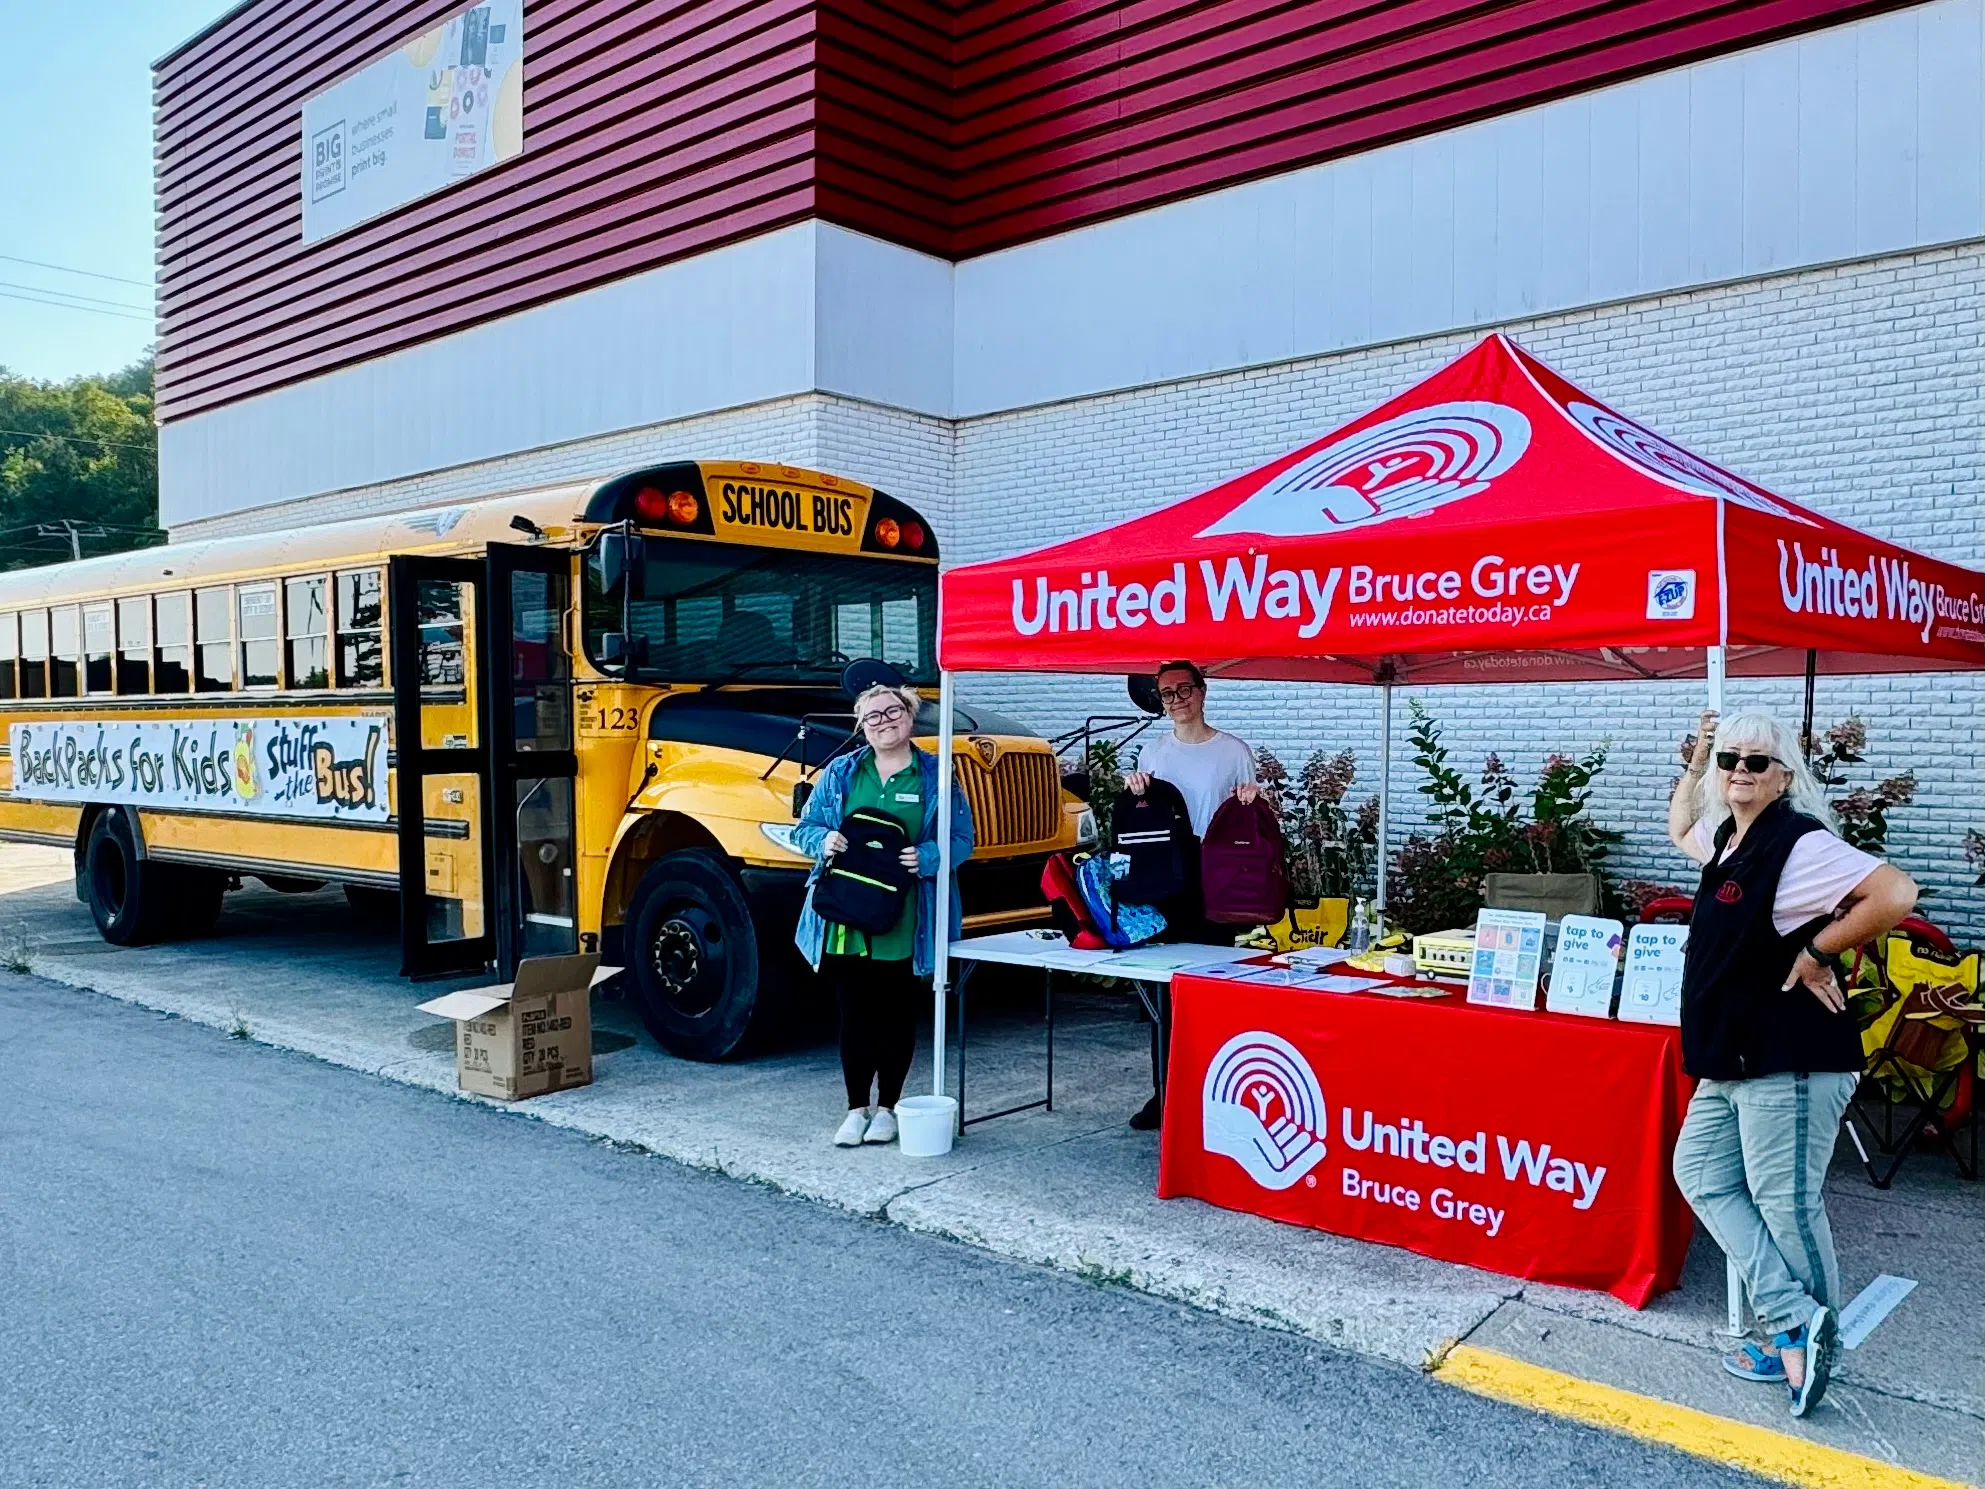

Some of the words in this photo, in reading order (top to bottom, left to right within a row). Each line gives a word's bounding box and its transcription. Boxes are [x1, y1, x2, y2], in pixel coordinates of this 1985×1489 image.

[316, 133, 341, 167] BIG
[352, 155, 371, 180] print
[373, 149, 386, 166] big
[722, 483, 808, 530] SCHOOL
[812, 495, 853, 536] BUS
[1012, 562, 1186, 636] United
[1199, 554, 1343, 638] Way
[1349, 565, 1462, 604] Bruce
[1471, 555, 1581, 606] Grey
[1777, 539, 1878, 619] United
[1881, 557, 1935, 643] Way
[1936, 584, 1969, 622] Bruce
[1350, 602, 1551, 627] www.donatetoday.ca
[598, 708, 638, 730] 123
[172, 728, 233, 797] Kids
[284, 770, 314, 801] the
[314, 725, 380, 810] Bus!
[1563, 938, 1589, 951] give
[1566, 925, 1587, 938] tap
[1591, 928, 1604, 939] to
[1635, 934, 1658, 947] tap
[1662, 935, 1676, 945] to
[1634, 946, 1661, 959] give
[1342, 1107, 1486, 1174] United
[1497, 1135, 1607, 1210] Way
[1342, 1167, 1421, 1211] Bruce
[1430, 1187, 1505, 1237] Grey
